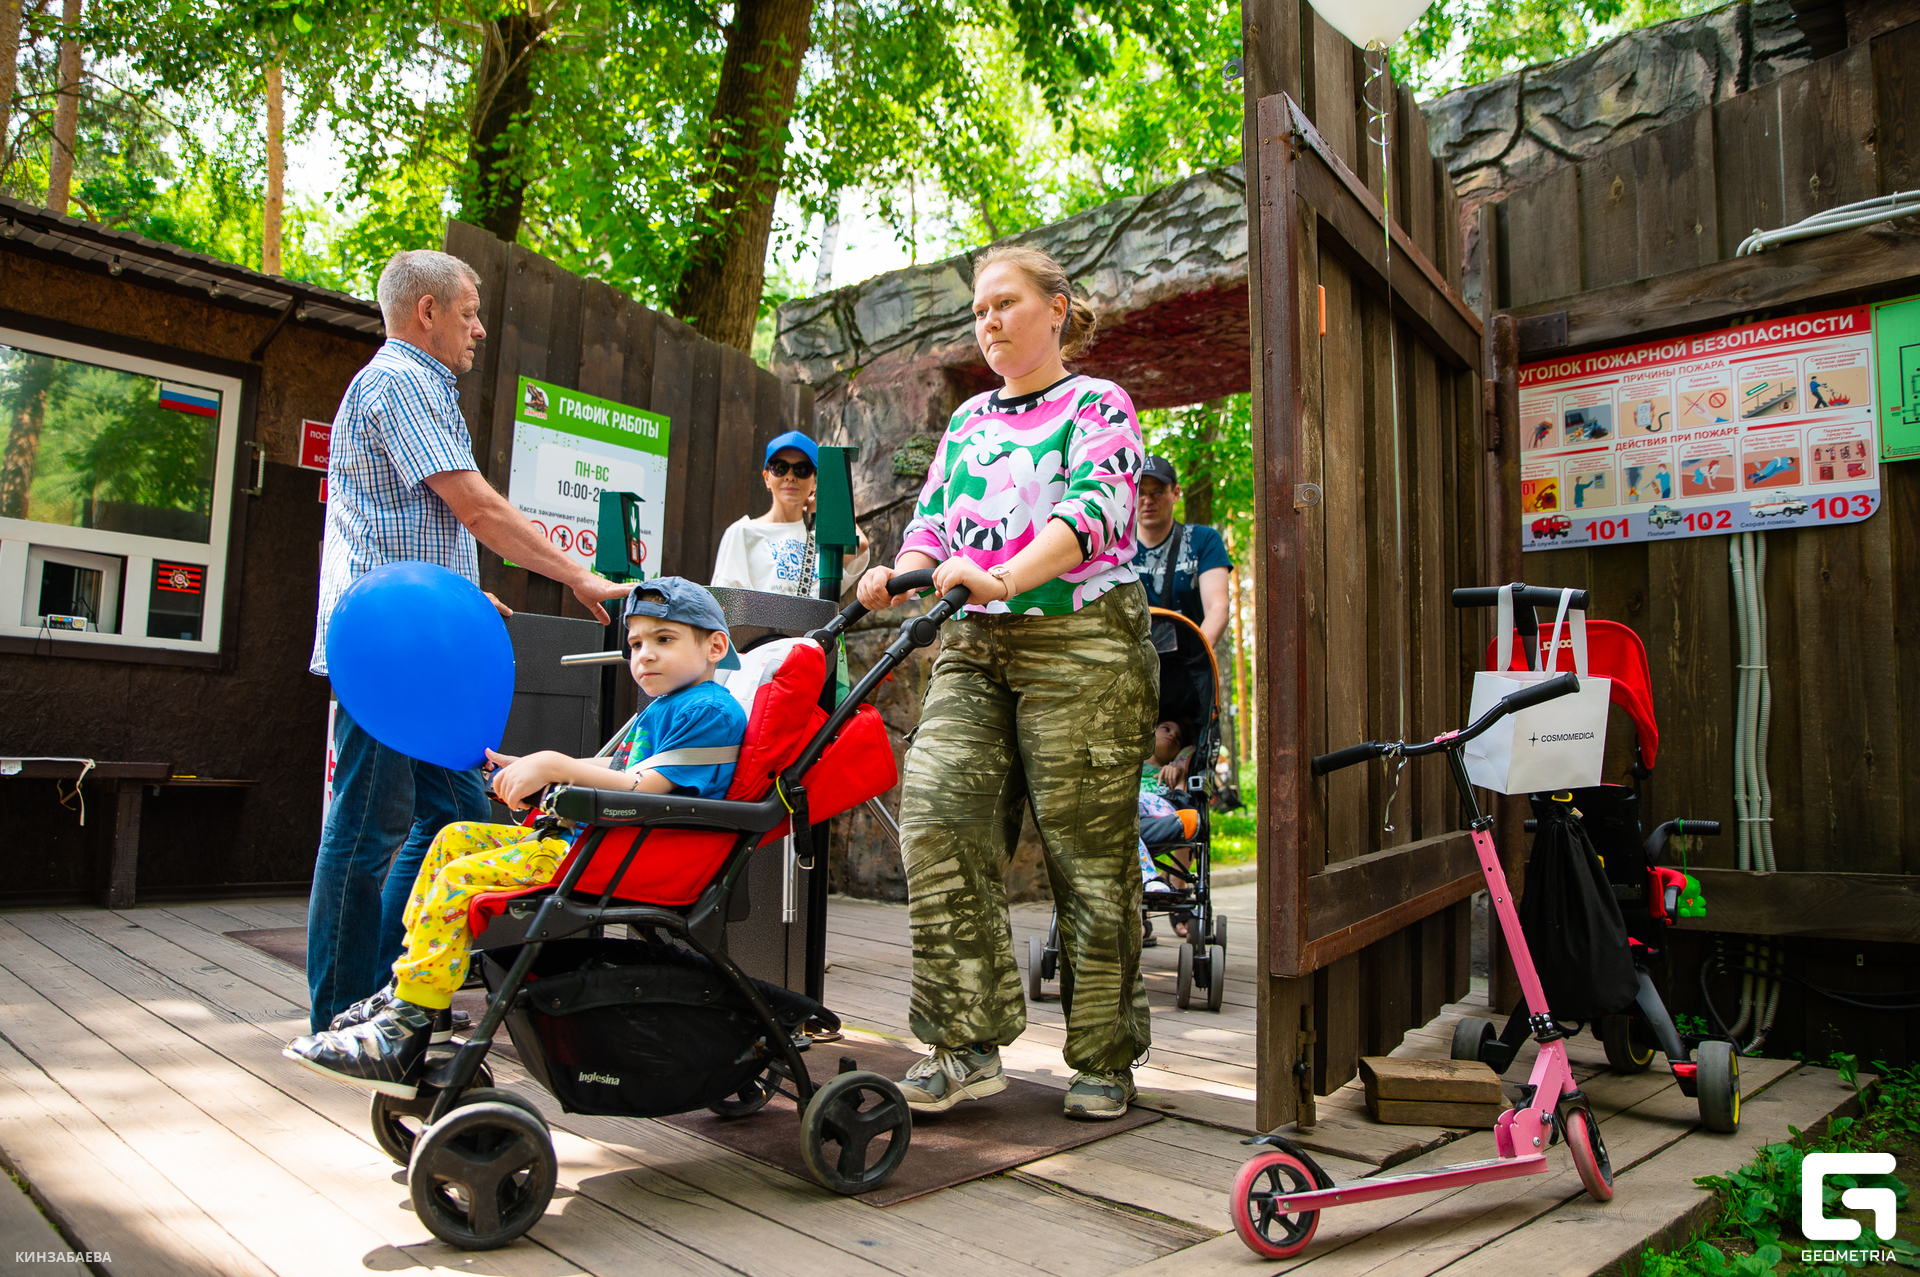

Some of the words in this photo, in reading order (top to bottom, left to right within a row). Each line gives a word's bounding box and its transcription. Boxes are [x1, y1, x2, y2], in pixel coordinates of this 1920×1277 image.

[1519, 360, 1582, 384] УГОЛОК
[1585, 340, 1687, 373] ПОЖАРНОЙ
[1691, 314, 1854, 353] БЕЗОПАСНОСТИ
[1623, 367, 1676, 384] ПРИЧИНЫ
[1679, 360, 1725, 375] ПОЖАРА
[558, 396, 610, 427] ГРАФИК
[612, 411, 660, 439] РАБОТЫ
[1615, 433, 1667, 452] ДЕЙСТВИЯ
[1670, 432, 1693, 444] ПРИ
[1694, 426, 1740, 440] ПОЖАРЕ
[575, 460, 610, 482] ПН-ВС
[558, 479, 606, 503] 10:00-2
[519, 504, 537, 514] Касса
[538, 509, 576, 522] заканчивает
[576, 516, 596, 527] работу
[1811, 494, 1872, 520] 103
[1585, 518, 1629, 541] 101
[1683, 510, 1732, 532] 102
[1541, 731, 1595, 743] COSMOMEDICA
[603, 808, 637, 817] espresso
[578, 1071, 620, 1085] Inglesina
